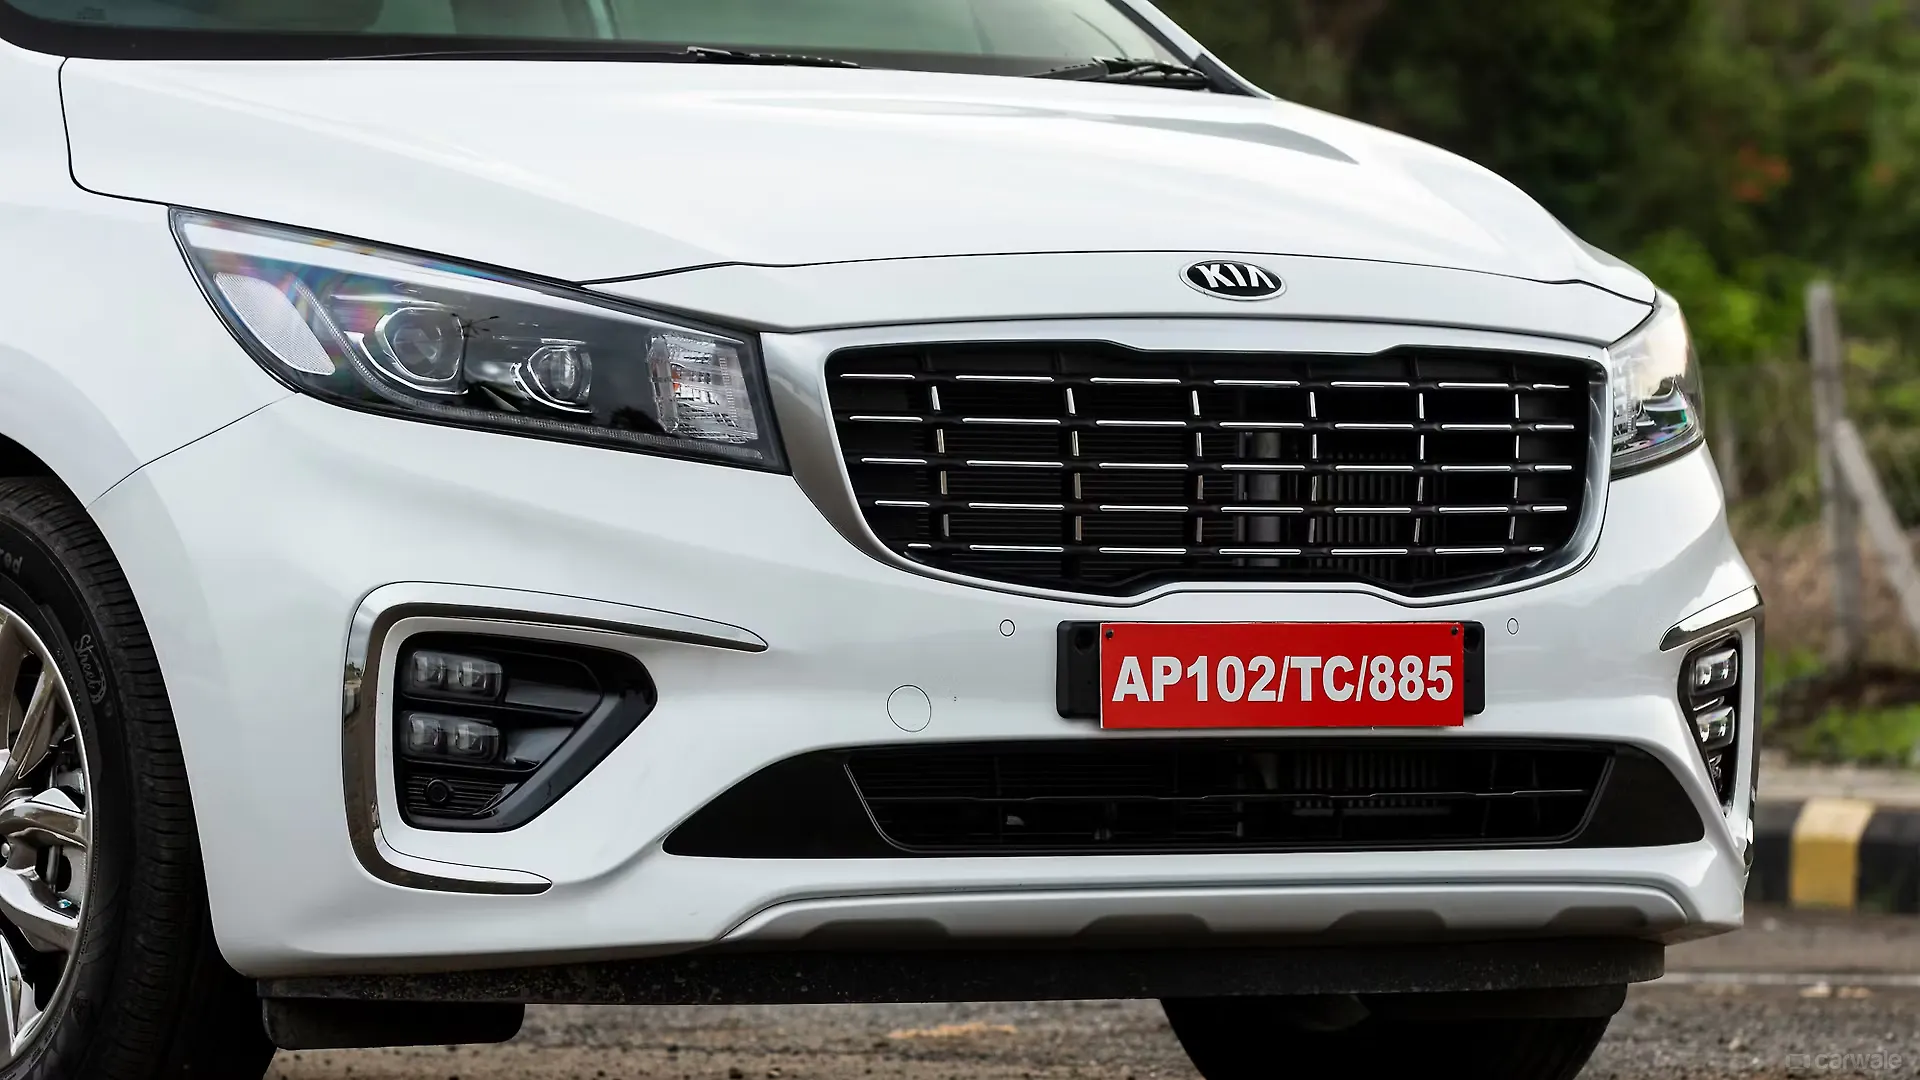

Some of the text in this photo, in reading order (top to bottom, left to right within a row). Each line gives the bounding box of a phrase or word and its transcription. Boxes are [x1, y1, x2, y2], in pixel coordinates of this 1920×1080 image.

[1195, 263, 1276, 289] KIA
[74, 633, 102, 690] Street
[1112, 655, 1453, 702] AP102/TC/885
